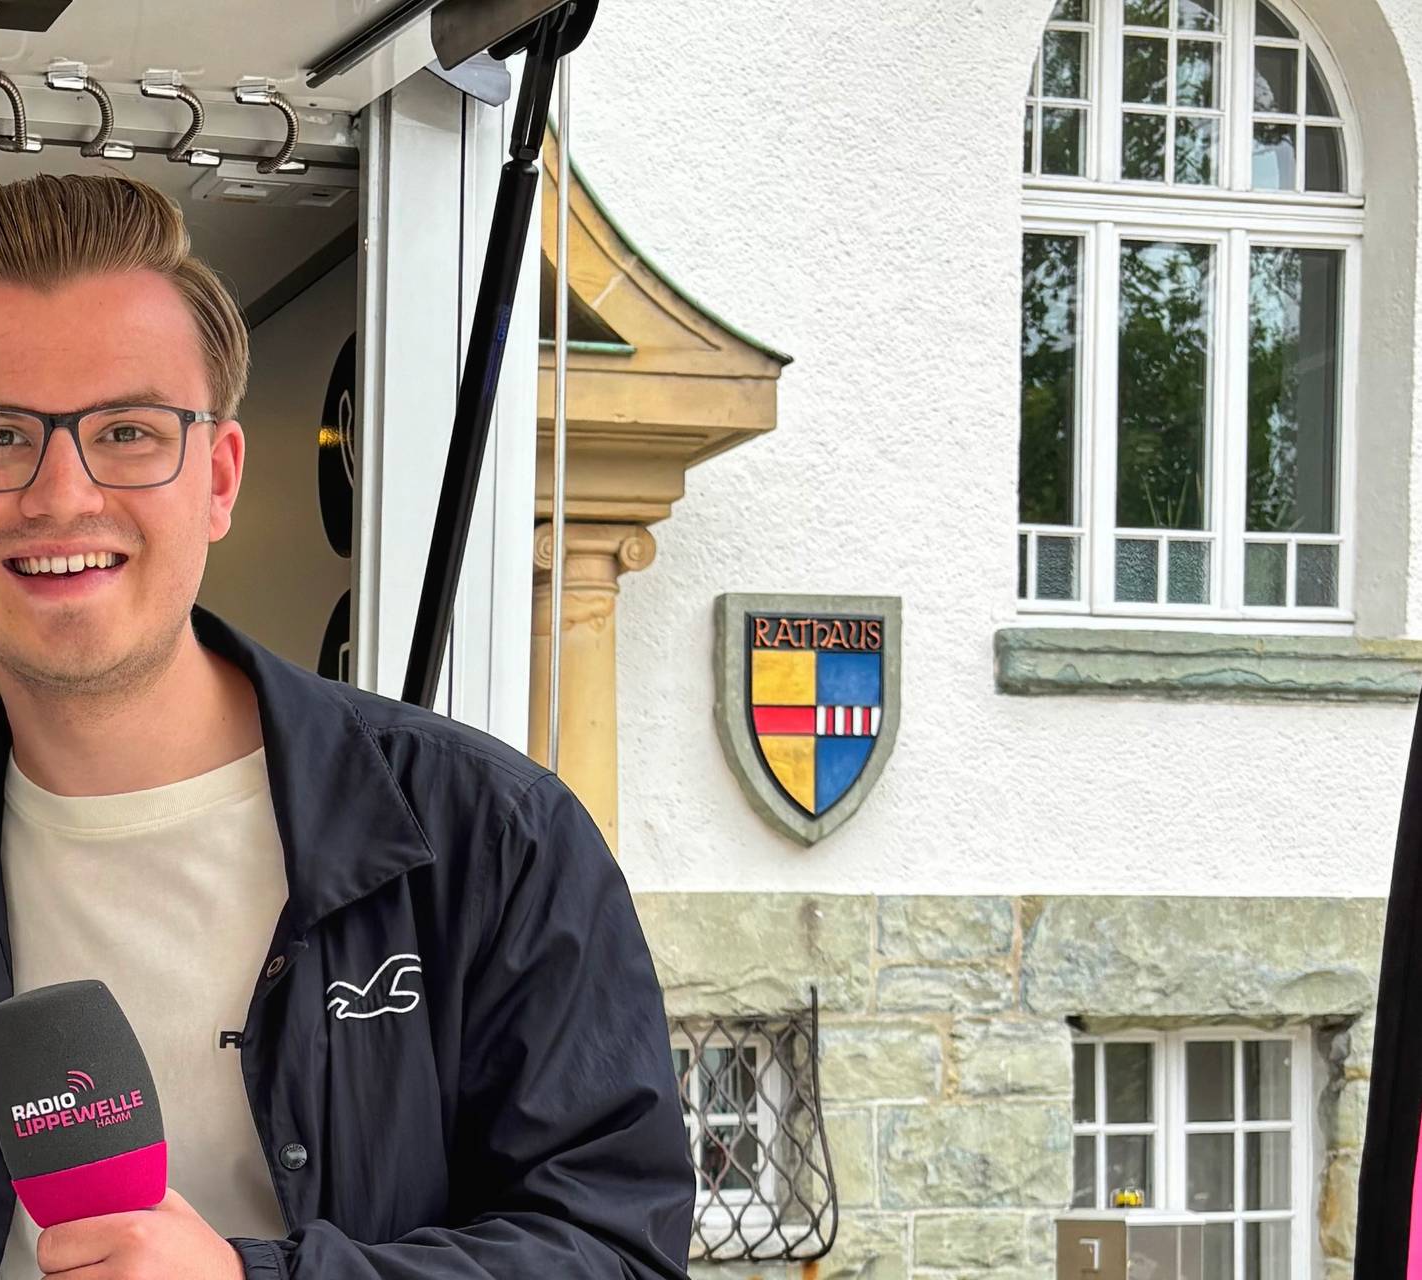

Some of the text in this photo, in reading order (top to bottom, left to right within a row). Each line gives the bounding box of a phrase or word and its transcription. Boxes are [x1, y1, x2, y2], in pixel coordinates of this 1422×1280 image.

[11, 1092, 76, 1122] RADIO
[14, 1089, 144, 1138] LIPPEWELLE
[95, 1111, 132, 1129] HAMM
